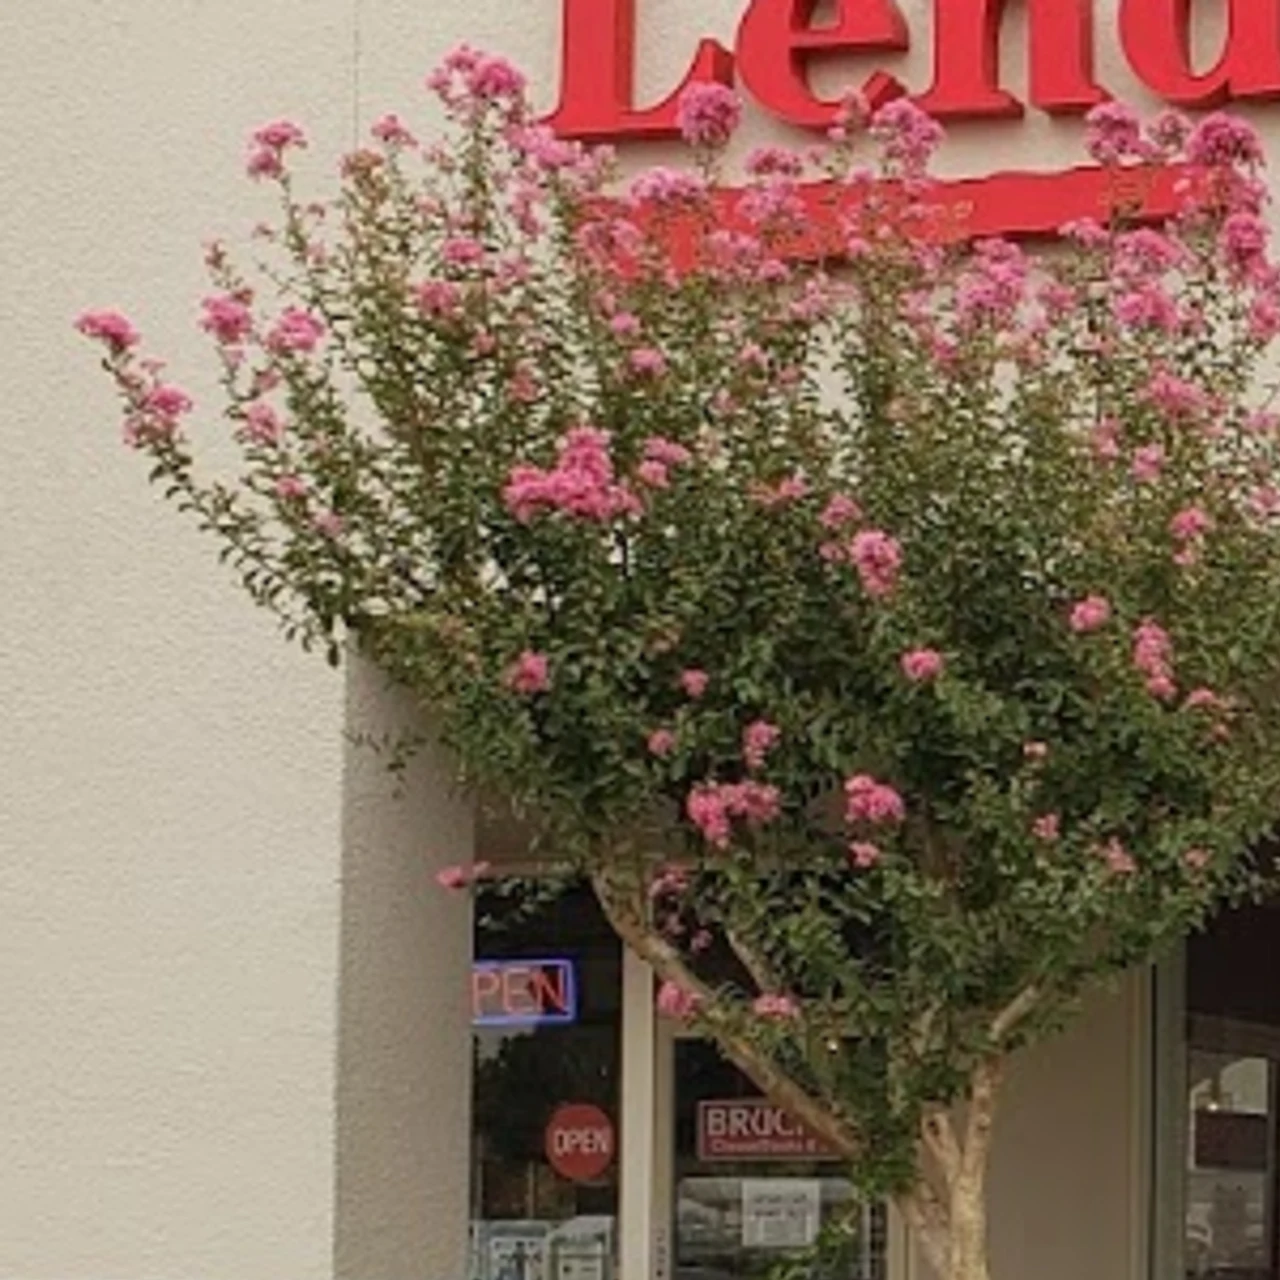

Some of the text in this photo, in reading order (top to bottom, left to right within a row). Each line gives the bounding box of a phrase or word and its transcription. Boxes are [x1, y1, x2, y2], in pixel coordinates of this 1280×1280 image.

[472, 966, 568, 1016] PEN
[707, 1107, 803, 1137] BRUC
[553, 1126, 612, 1157] OPEN
